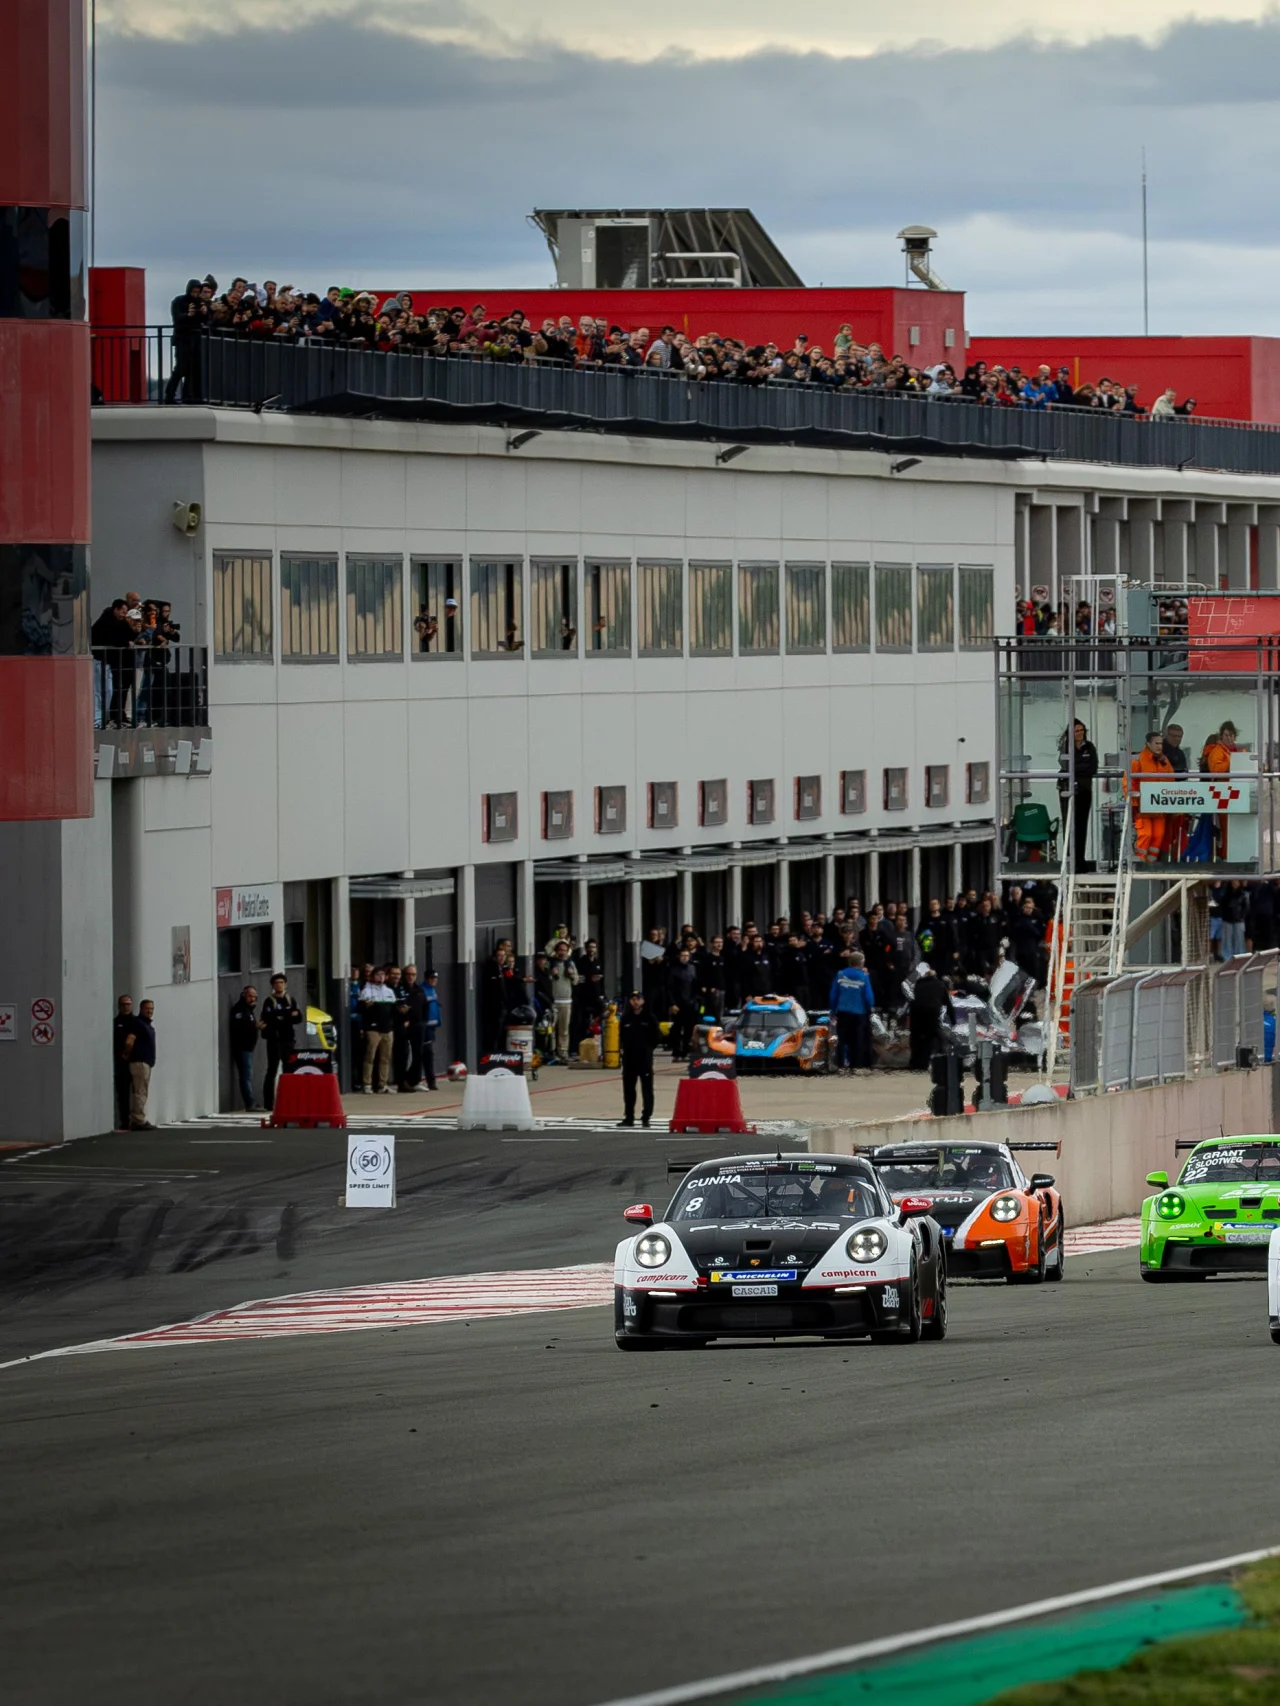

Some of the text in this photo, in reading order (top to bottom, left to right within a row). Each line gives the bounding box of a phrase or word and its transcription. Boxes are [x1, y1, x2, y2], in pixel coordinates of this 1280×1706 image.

[1161, 788, 1198, 796] Circuito de
[1150, 793, 1205, 806] Navarra
[362, 1155, 379, 1168] 50
[1189, 1149, 1246, 1164] C. GRANT
[1187, 1156, 1244, 1172] T. SLOOTWEG
[1183, 1167, 1209, 1183] 22
[687, 1175, 741, 1189] CUNHA
[685, 1197, 704, 1212] 8
[821, 1269, 877, 1279] campicarn
[733, 1286, 777, 1296] CASCAIS
